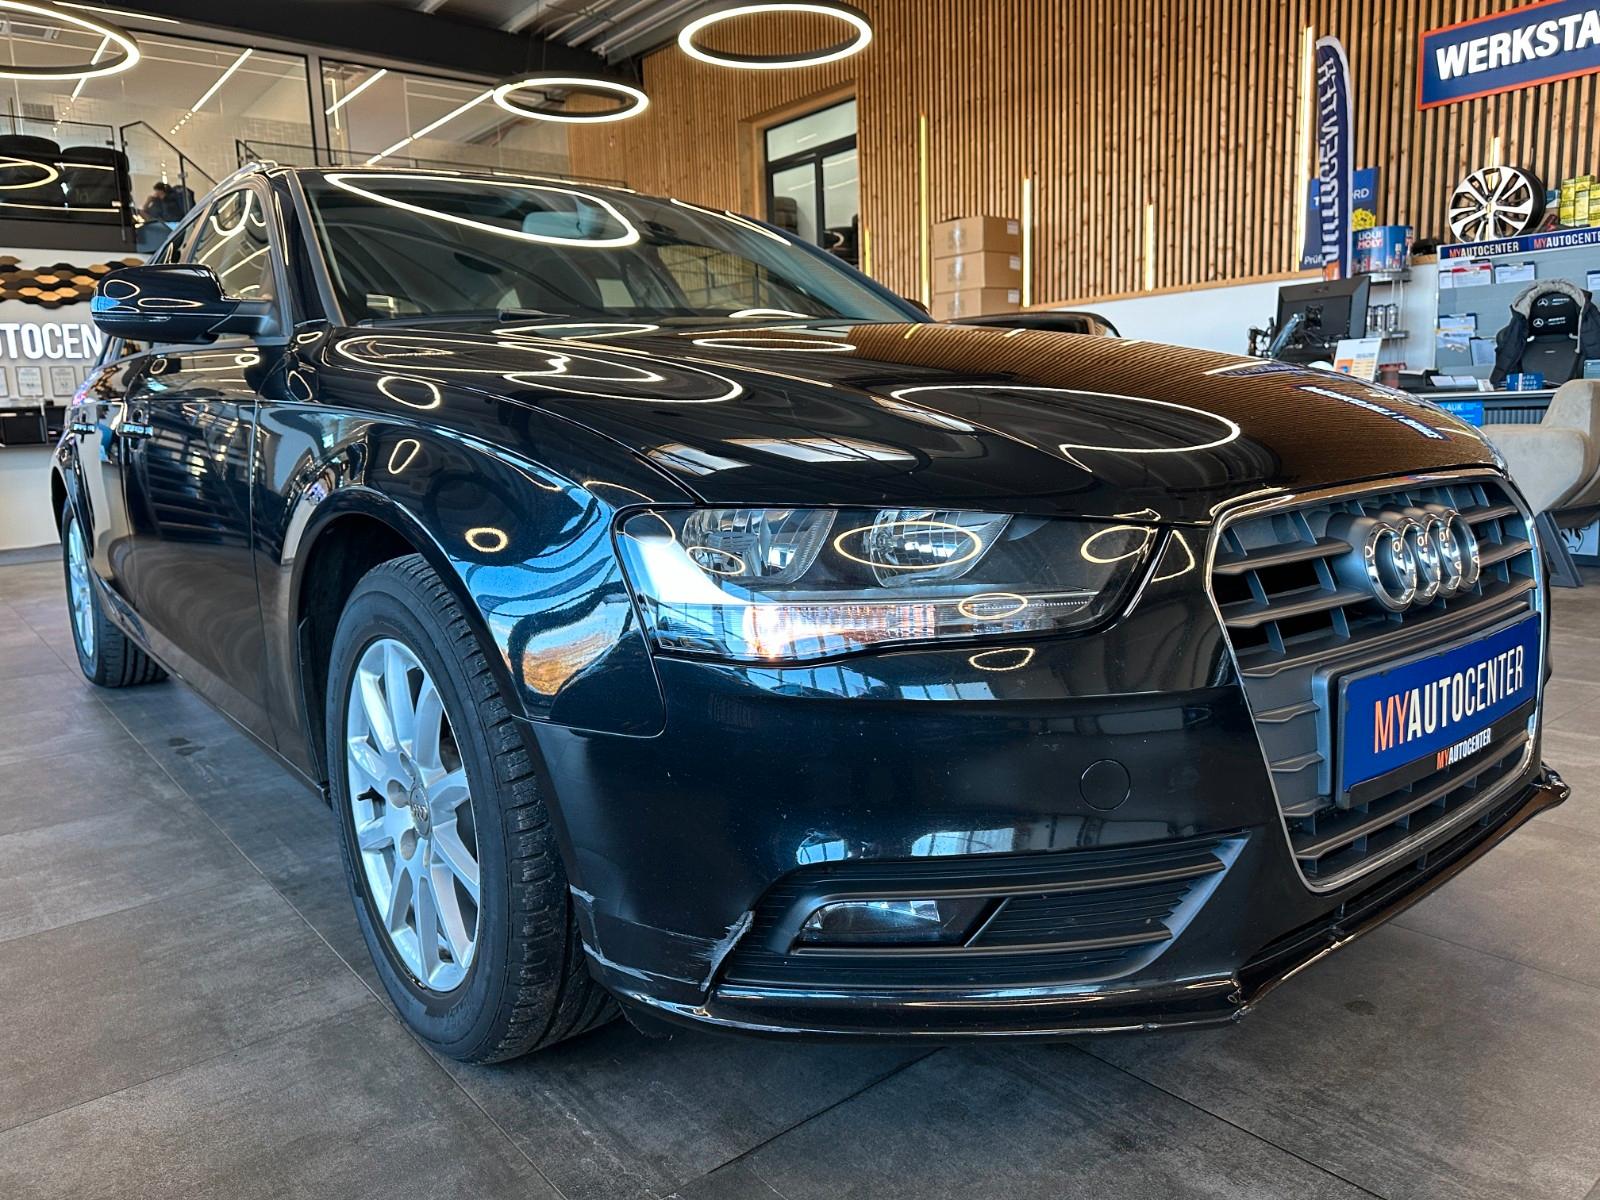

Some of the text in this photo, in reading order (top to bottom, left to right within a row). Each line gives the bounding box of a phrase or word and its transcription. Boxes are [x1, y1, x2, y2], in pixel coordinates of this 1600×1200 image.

[1436, 9, 1600, 81] WERKSTA
[1449, 241, 1519, 258] MYAUTOCENTER
[0, 322, 103, 359] TOCEN
[1374, 645, 1524, 754] MYAUTOCENTER
[1436, 727, 1491, 770] MYAUTOCENTER
